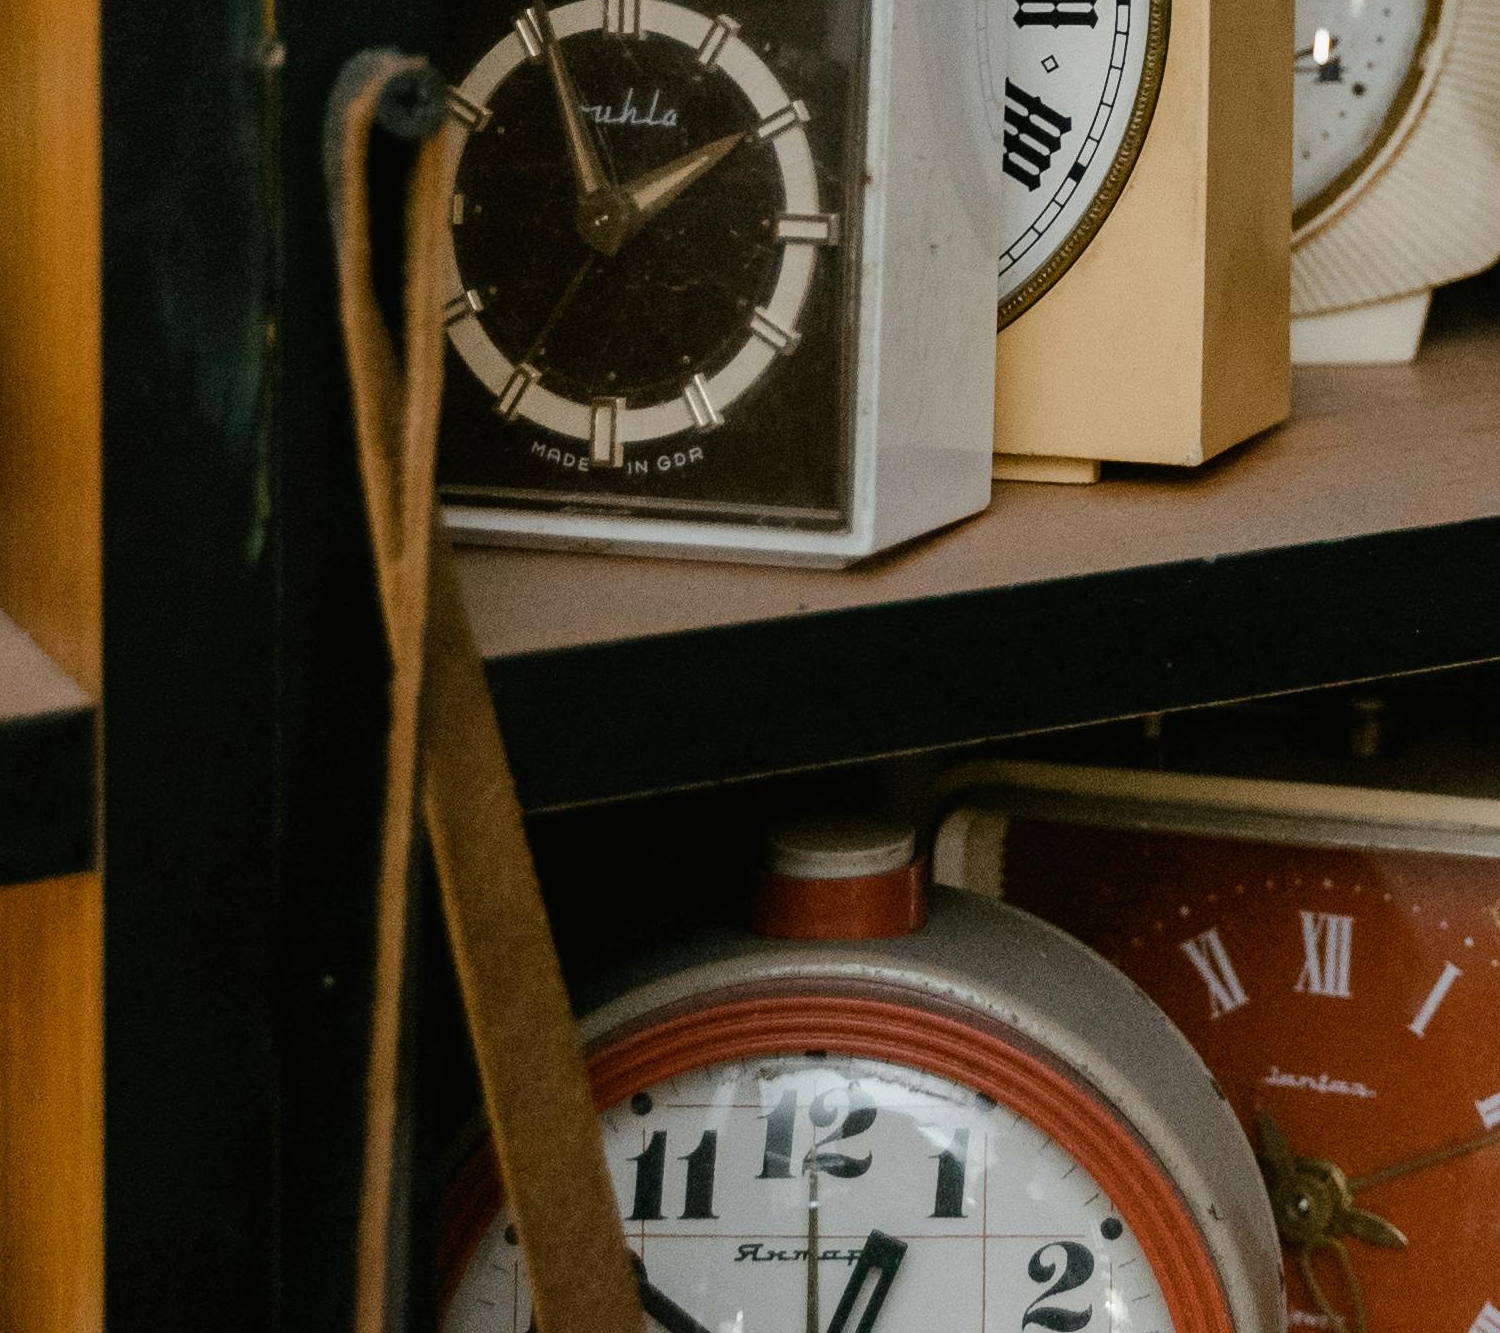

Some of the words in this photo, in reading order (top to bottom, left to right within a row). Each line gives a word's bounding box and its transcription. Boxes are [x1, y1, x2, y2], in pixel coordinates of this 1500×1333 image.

[531, 441, 590, 472] MADE
[627, 459, 649, 475] IN
[656, 446, 704, 472] GDR
[1180, 928, 1250, 1021] XI
[1294, 910, 1355, 999] XII
[1408, 960, 1463, 1039] I
[627, 1130, 720, 1221] 11
[754, 1086, 878, 1180] 12
[927, 1126, 971, 1219] 1
[734, 1243, 863, 1266] Янтар
[1021, 1240, 1095, 1333] 2
